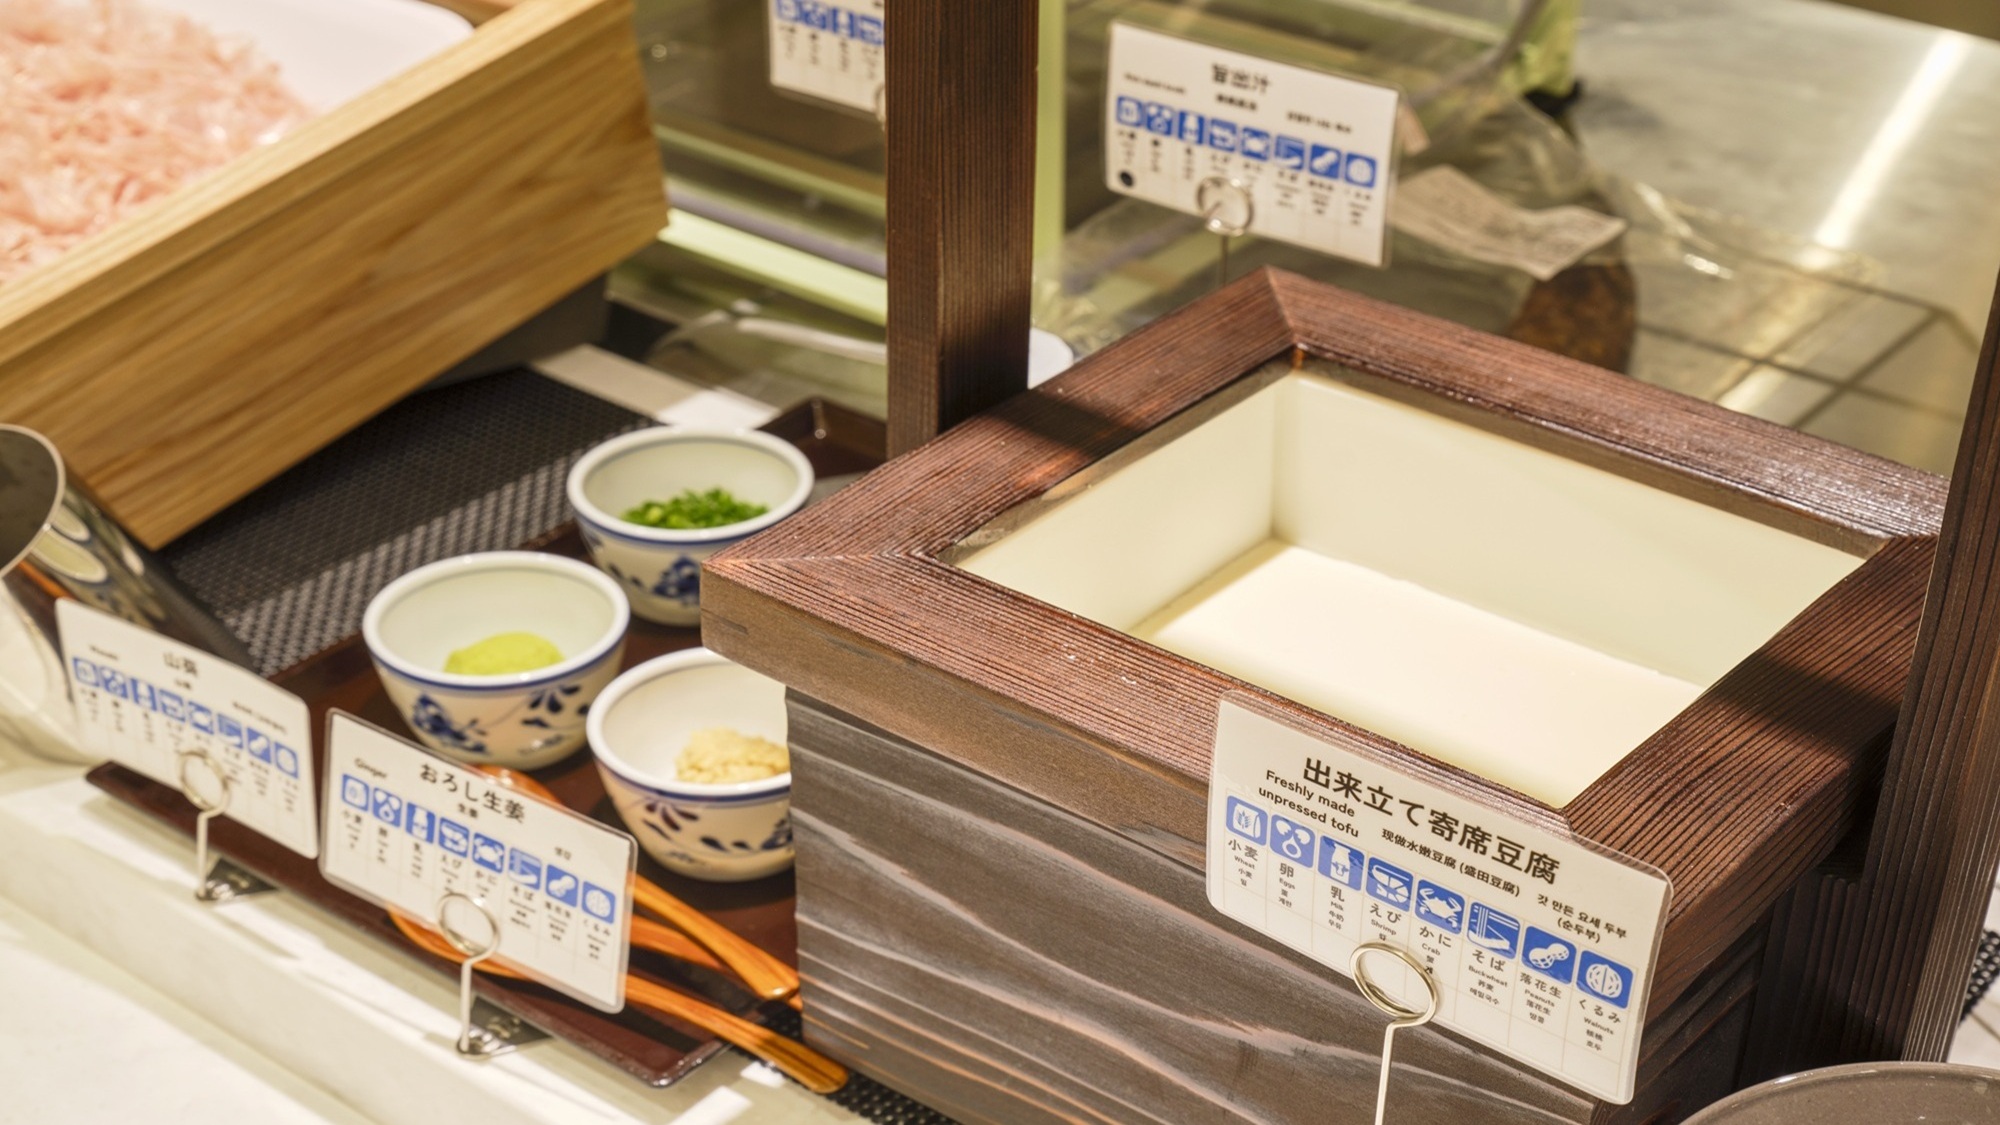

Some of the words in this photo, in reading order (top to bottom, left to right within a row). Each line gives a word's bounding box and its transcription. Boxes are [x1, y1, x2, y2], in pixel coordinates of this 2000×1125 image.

[420, 763, 526, 823] おろし生姜
[1266, 769, 1314, 801] Freshly
[1318, 794, 1355, 818] made
[1258, 786, 1327, 824] unpressed
[1331, 817, 1359, 838] tofu
[1303, 757, 1560, 885] 出来立て寄席豆腐
[1228, 838, 1259, 862] 小麦
[1234, 855, 1256, 870] Wheat
[1279, 862, 1295, 878] 卵
[1330, 885, 1345, 902] 乳
[1369, 903, 1402, 924] えび
[1370, 919, 1397, 937] Shrimp
[1419, 926, 1452, 949] かに
[1421, 942, 1441, 957] Crab
[1472, 949, 1507, 973] そば
[1468, 964, 1508, 988] Buckwheat
[1519, 971, 1562, 1000] 落花生
[1524, 988, 1555, 1008] Peanuts
[1579, 998, 1621, 1025] くるみ
[1583, 1016, 1614, 1036] Walnuts
